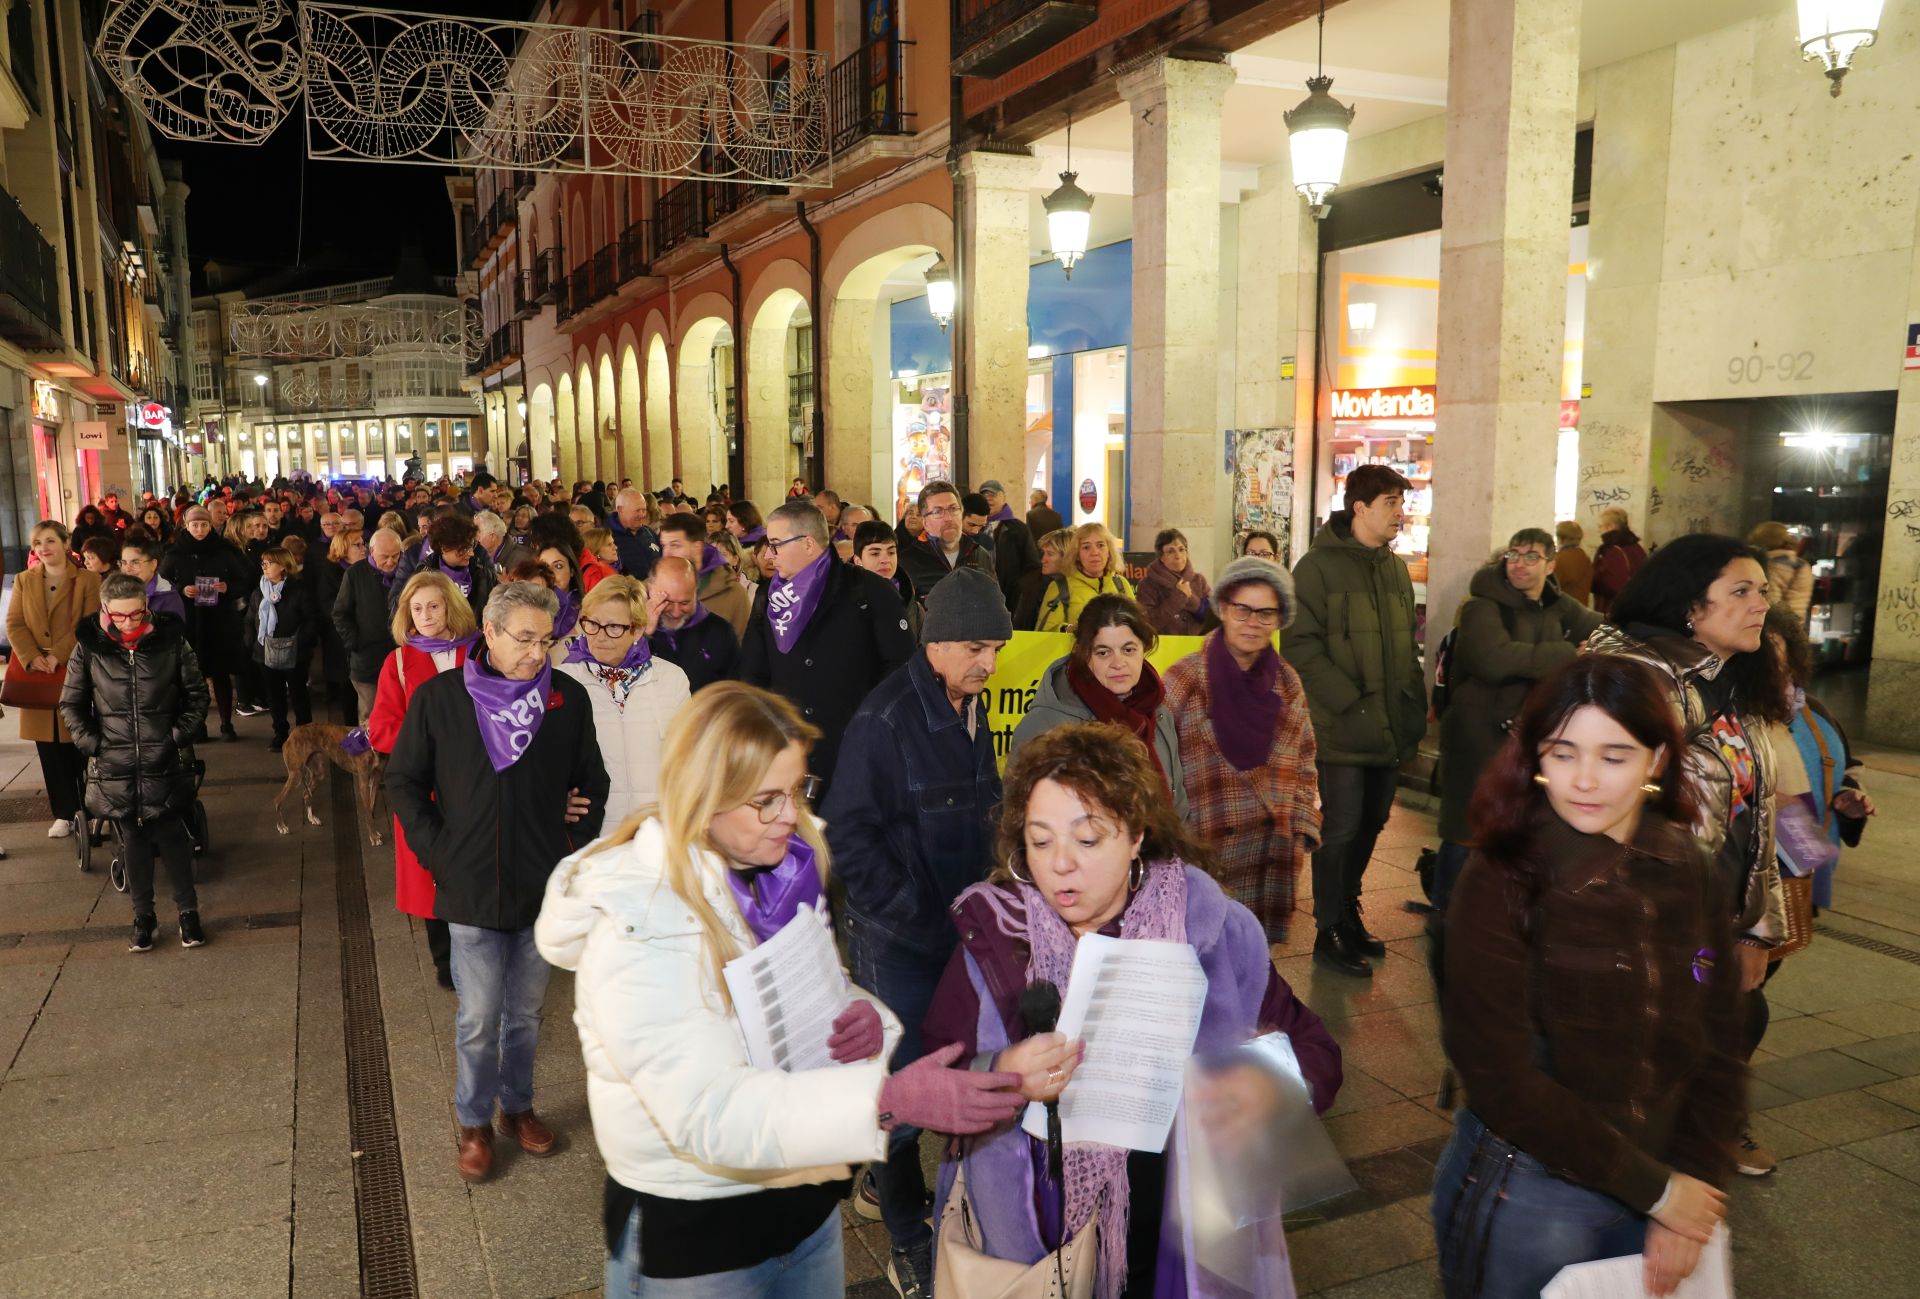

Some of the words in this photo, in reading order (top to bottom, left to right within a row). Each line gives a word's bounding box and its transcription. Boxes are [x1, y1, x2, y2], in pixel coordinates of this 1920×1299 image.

[1728, 351, 1815, 384] 90-92
[144, 410, 165, 420] BAR
[1331, 387, 1435, 418] Movilandia
